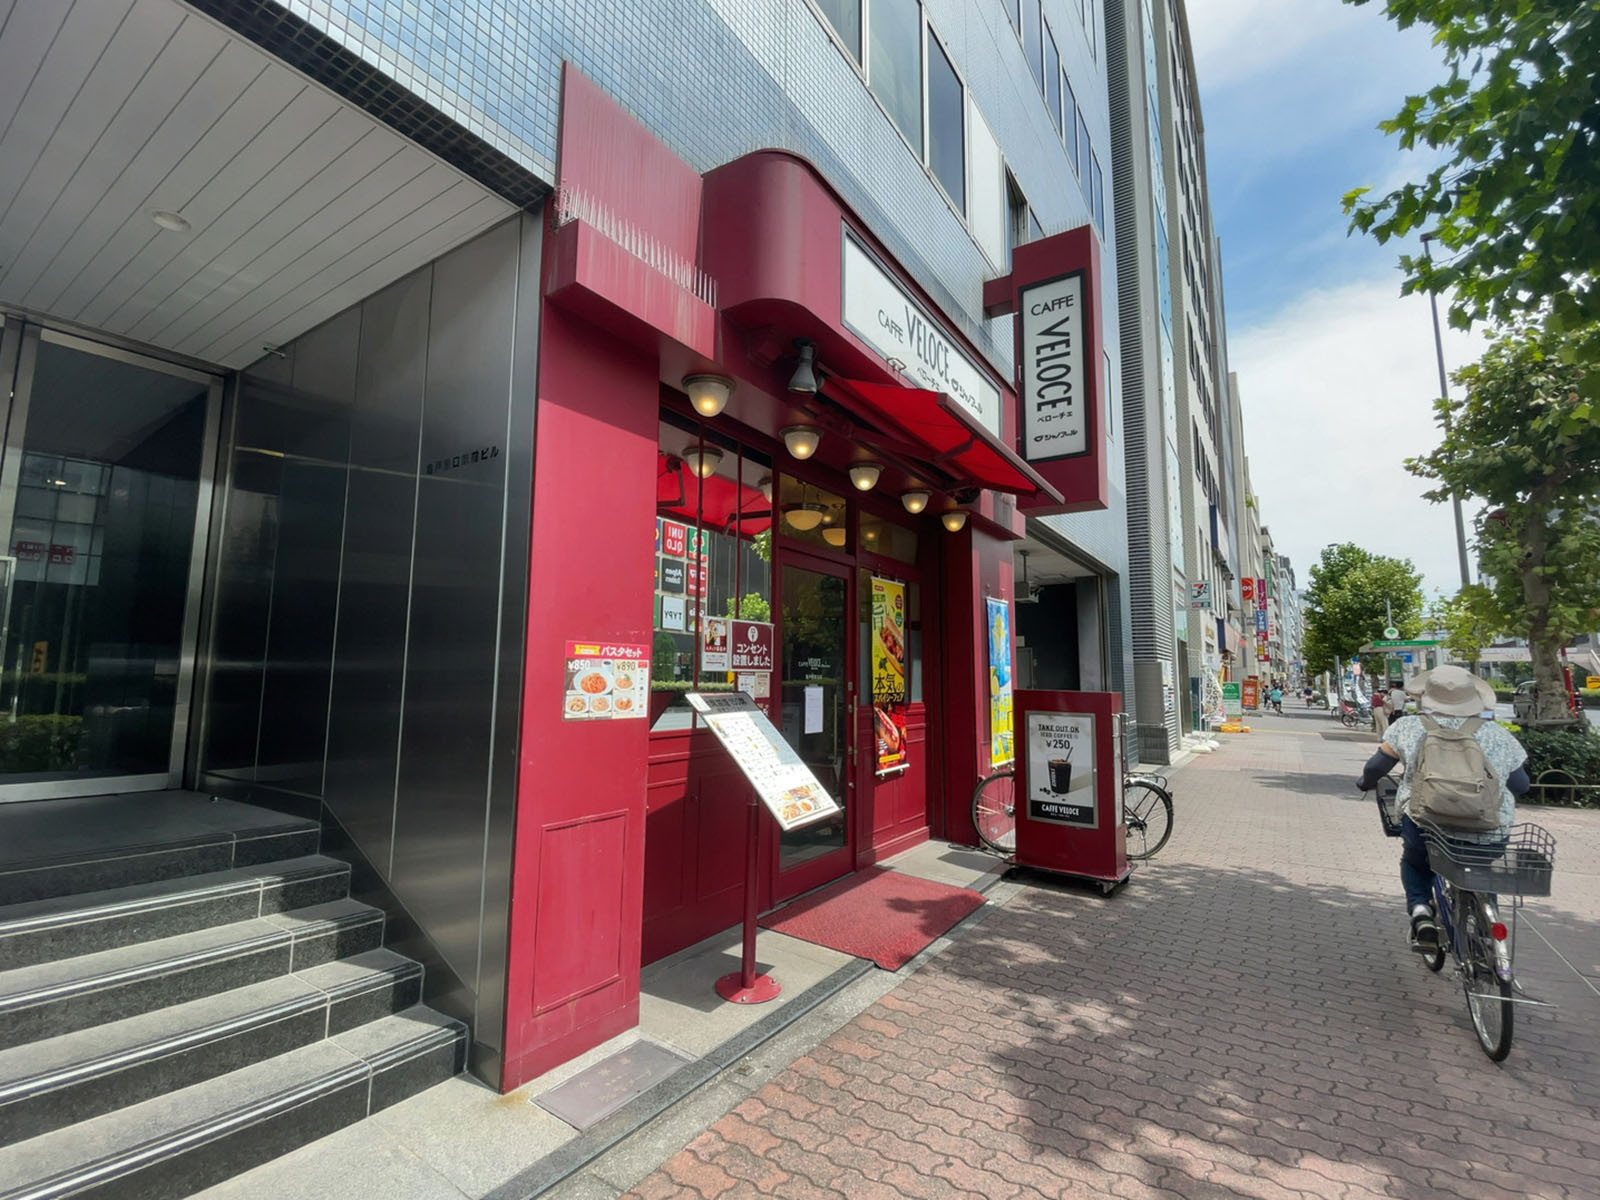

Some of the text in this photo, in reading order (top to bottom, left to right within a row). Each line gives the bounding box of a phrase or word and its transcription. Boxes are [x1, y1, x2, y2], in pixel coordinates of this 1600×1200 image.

[1030, 294, 1074, 317] CAFFE
[878, 305, 950, 385] CAFFE VELOCE
[1036, 316, 1073, 412] VELOCE
[916, 367, 941, 392] ベローチェ
[1037, 411, 1073, 423] ベローチェ
[601, 646, 643, 658] パスタセット
[736, 643, 768, 655] コンセント
[732, 654, 771, 667] 設置しました
[874, 672, 905, 693] 本気の
[1038, 724, 1054, 732] TAKE
[1046, 739, 1071, 750] ¥250
[1041, 804, 1058, 814] CAFFE
[1059, 806, 1080, 816] VELOCE
